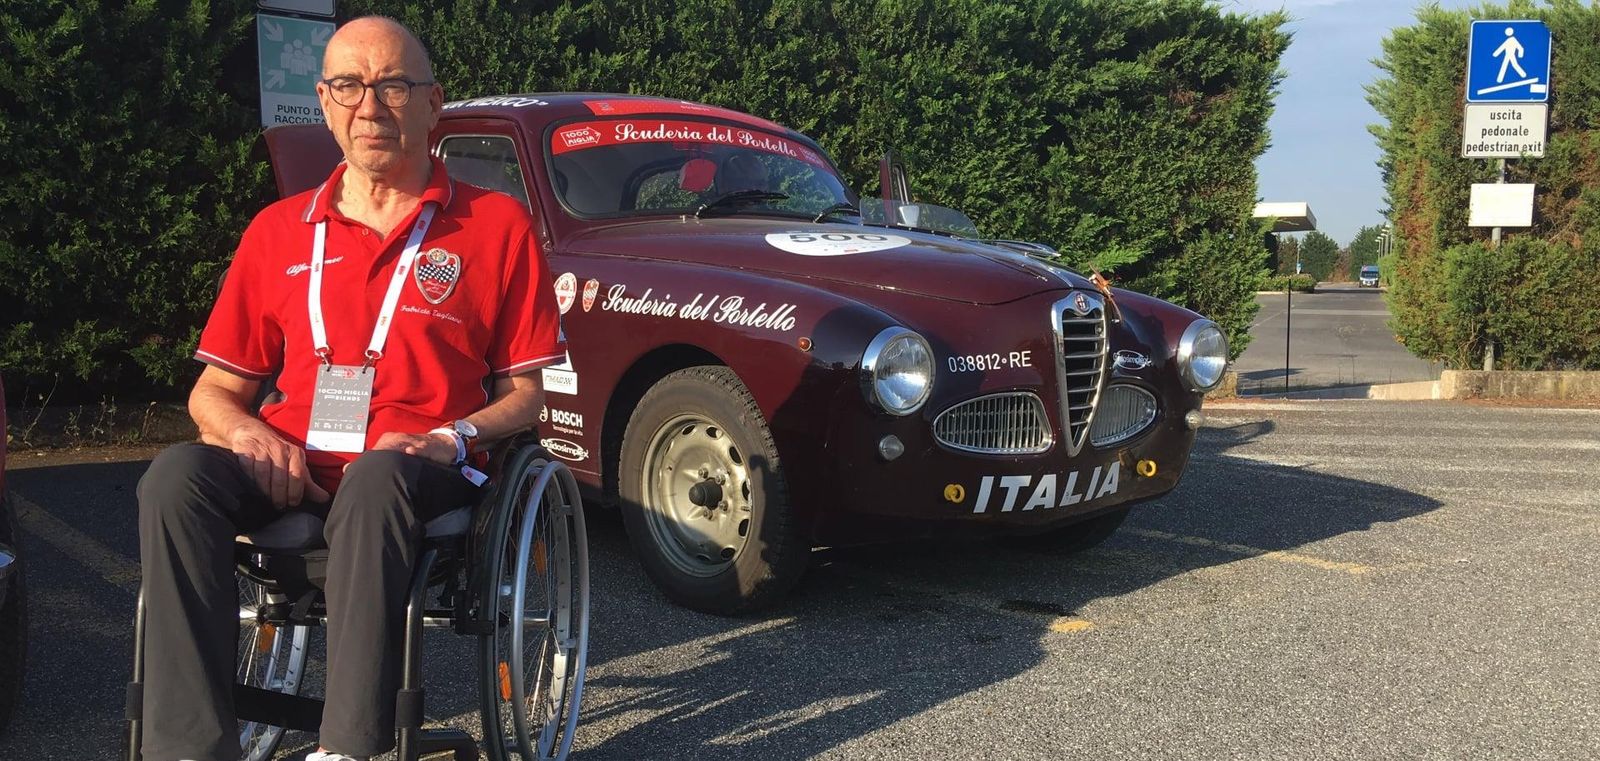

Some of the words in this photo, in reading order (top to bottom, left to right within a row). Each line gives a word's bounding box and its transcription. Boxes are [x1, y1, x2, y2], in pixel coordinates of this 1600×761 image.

[277, 104, 310, 115] PUNTO
[1490, 109, 1522, 120] uscita
[566, 130, 590, 139] 1000
[1481, 125, 1529, 139] pedonale
[614, 123, 703, 141] Scuderia
[706, 126, 734, 143] del
[737, 130, 798, 157] Portello
[1466, 141, 1519, 155] pedestrian
[1522, 141, 1542, 153] exit
[601, 283, 677, 318] Scuderia
[679, 293, 720, 321] del
[713, 295, 797, 332] Portello
[551, 408, 583, 428] BOSCH
[973, 461, 1121, 514] ITALIA
